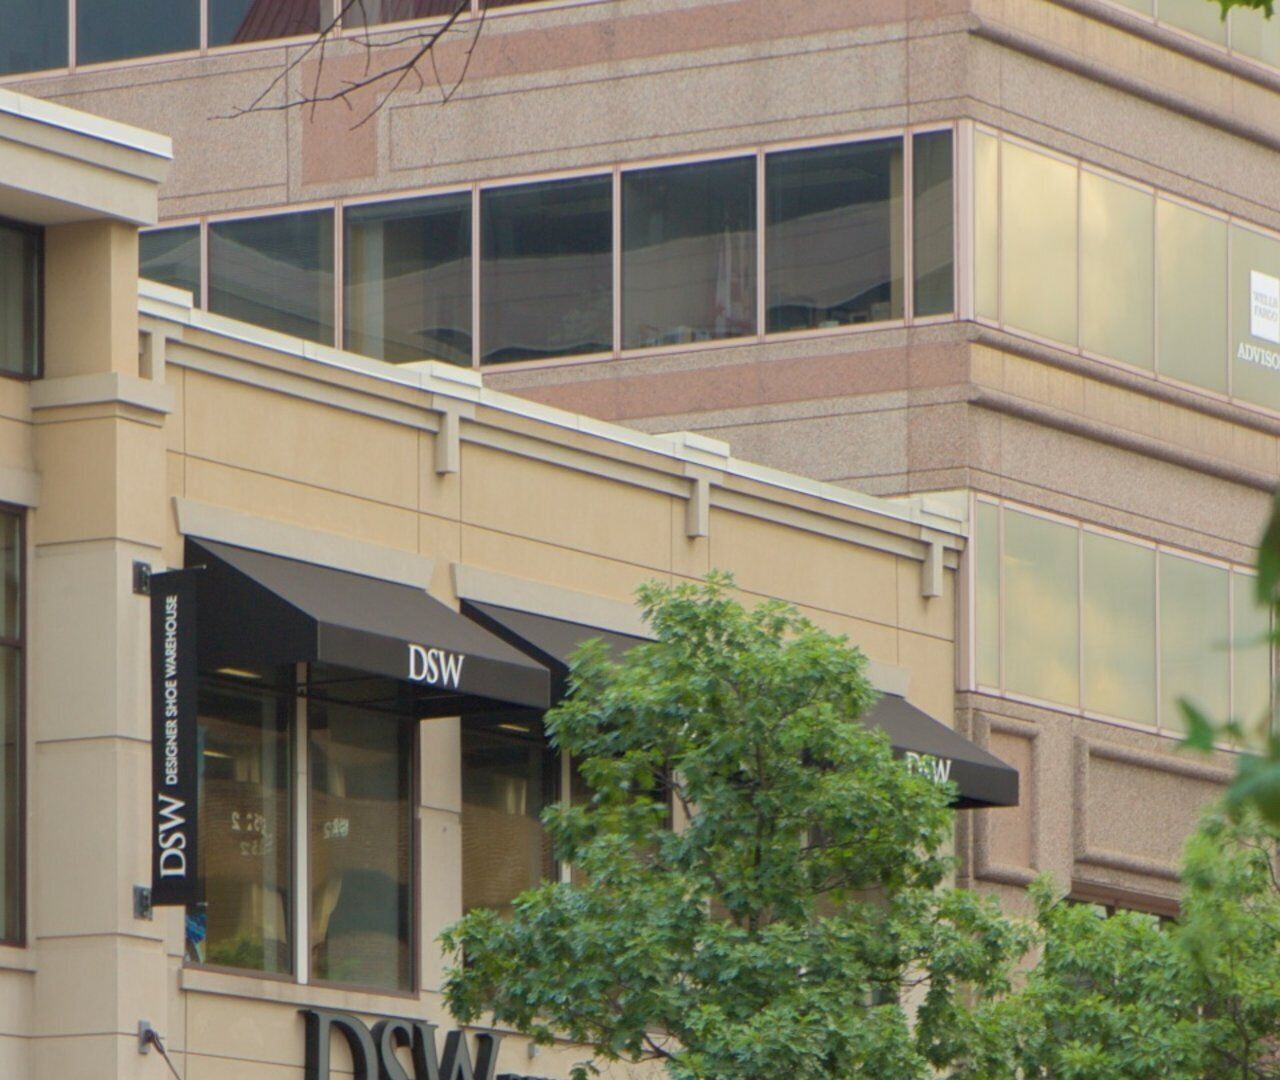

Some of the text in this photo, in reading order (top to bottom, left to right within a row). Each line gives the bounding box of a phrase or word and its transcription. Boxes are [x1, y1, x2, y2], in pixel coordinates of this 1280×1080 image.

[158, 594, 187, 879] DSW DESIGNER SHOE WAREHOUSE
[408, 644, 465, 689] DSW
